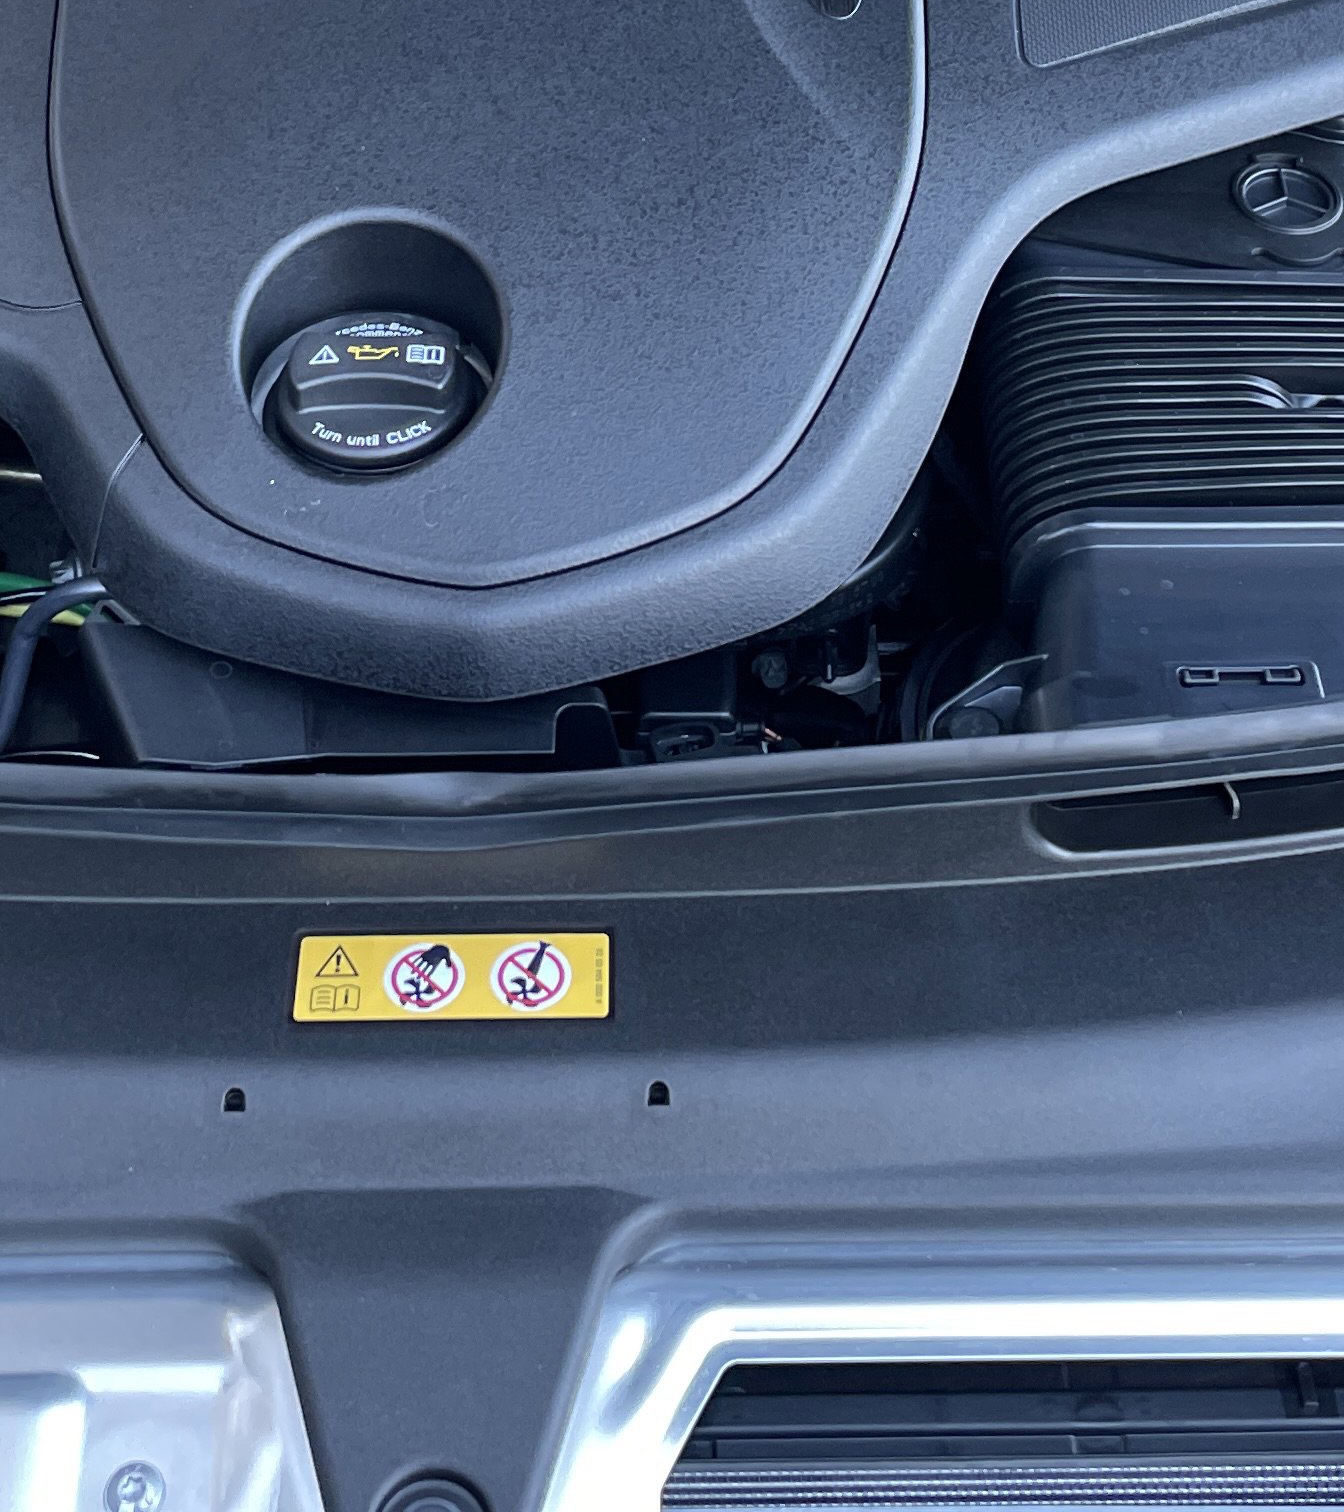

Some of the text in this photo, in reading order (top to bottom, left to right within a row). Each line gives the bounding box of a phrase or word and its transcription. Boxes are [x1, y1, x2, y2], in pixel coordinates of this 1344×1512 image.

[310, 420, 432, 447] Turn until CLICK
